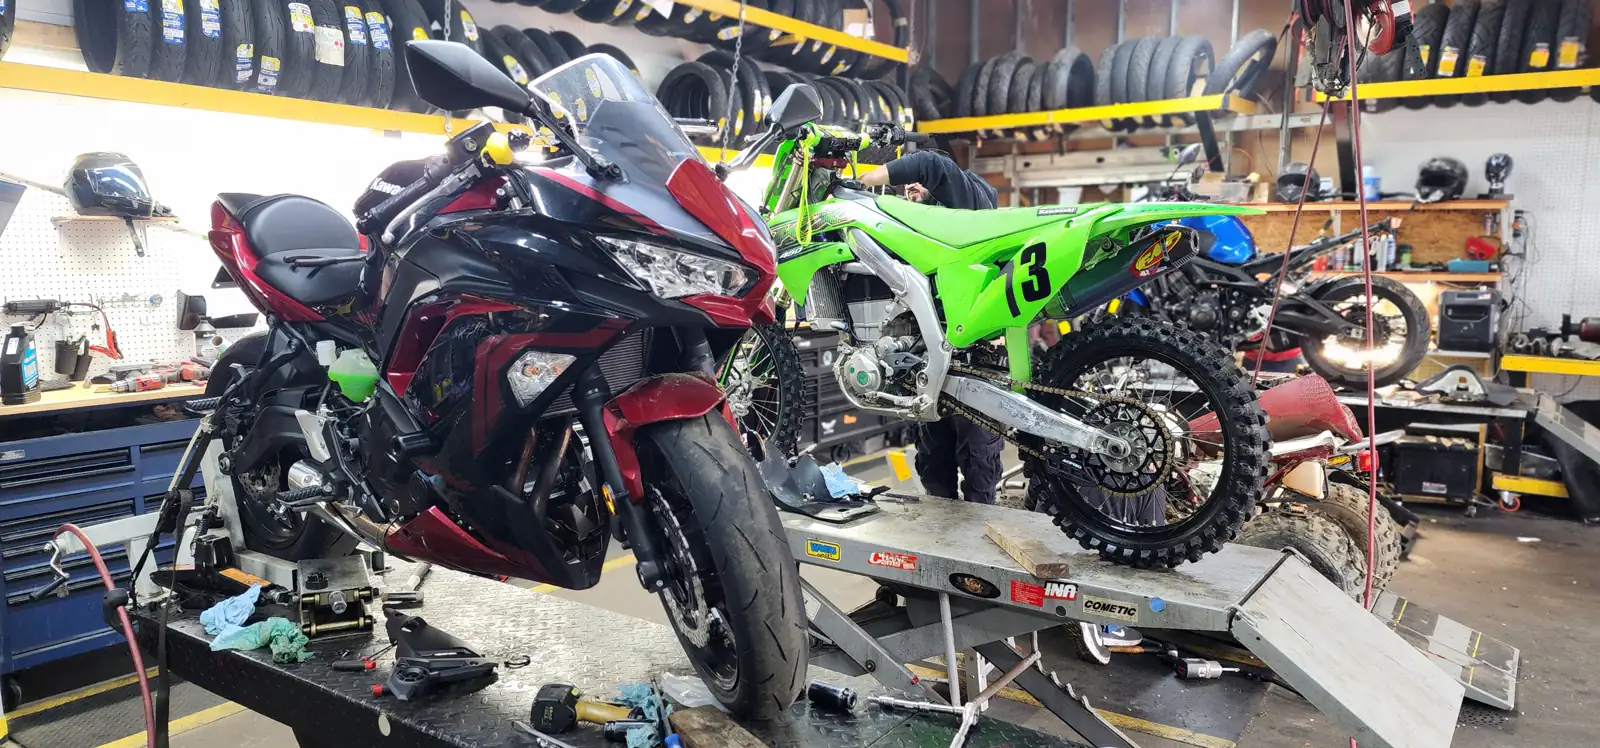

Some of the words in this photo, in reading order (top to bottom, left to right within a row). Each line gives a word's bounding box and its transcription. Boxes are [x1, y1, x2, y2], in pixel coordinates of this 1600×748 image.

[1038, 207, 1075, 215] Kawasaki
[1044, 582, 1077, 598] INA
[1084, 600, 1137, 617] COMETIC
